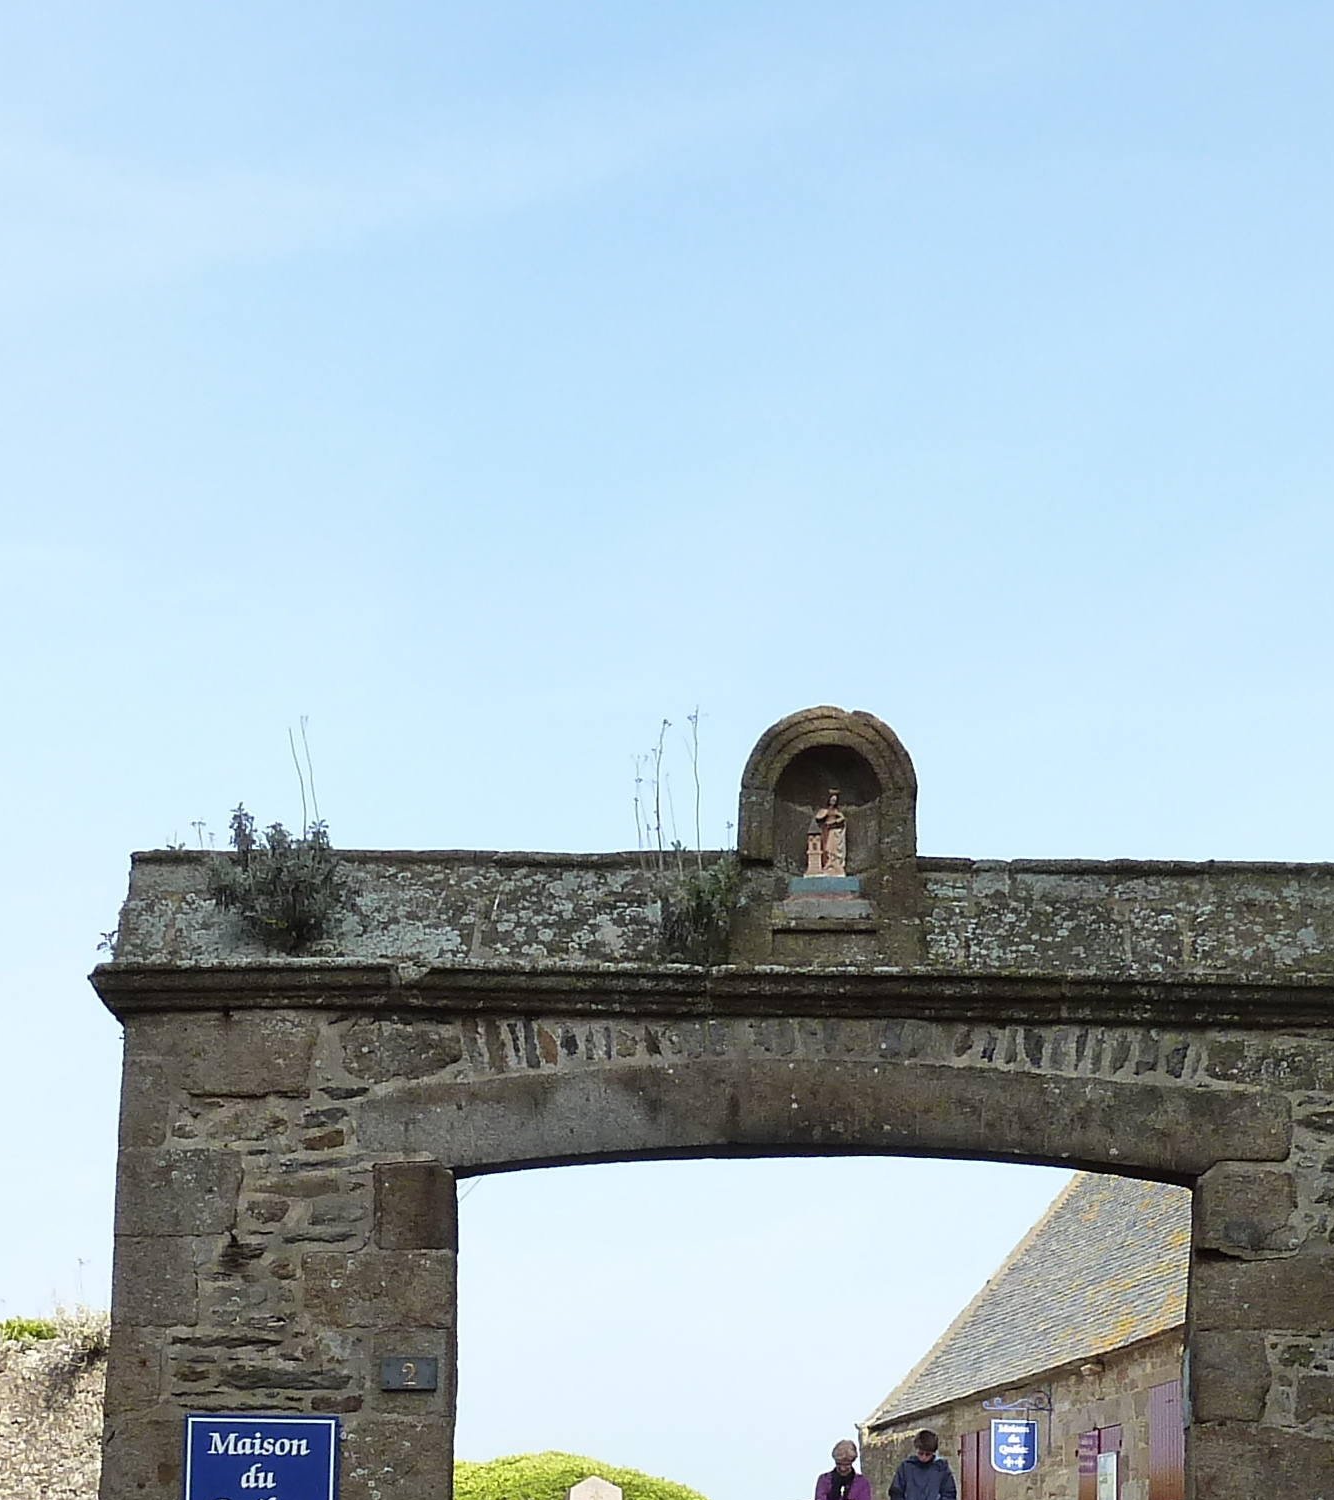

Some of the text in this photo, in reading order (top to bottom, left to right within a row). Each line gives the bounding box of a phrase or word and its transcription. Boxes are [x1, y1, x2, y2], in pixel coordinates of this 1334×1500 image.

[402, 1362, 416, 1385] 2
[207, 1432, 310, 1455] Maison
[240, 1463, 276, 1488] du
